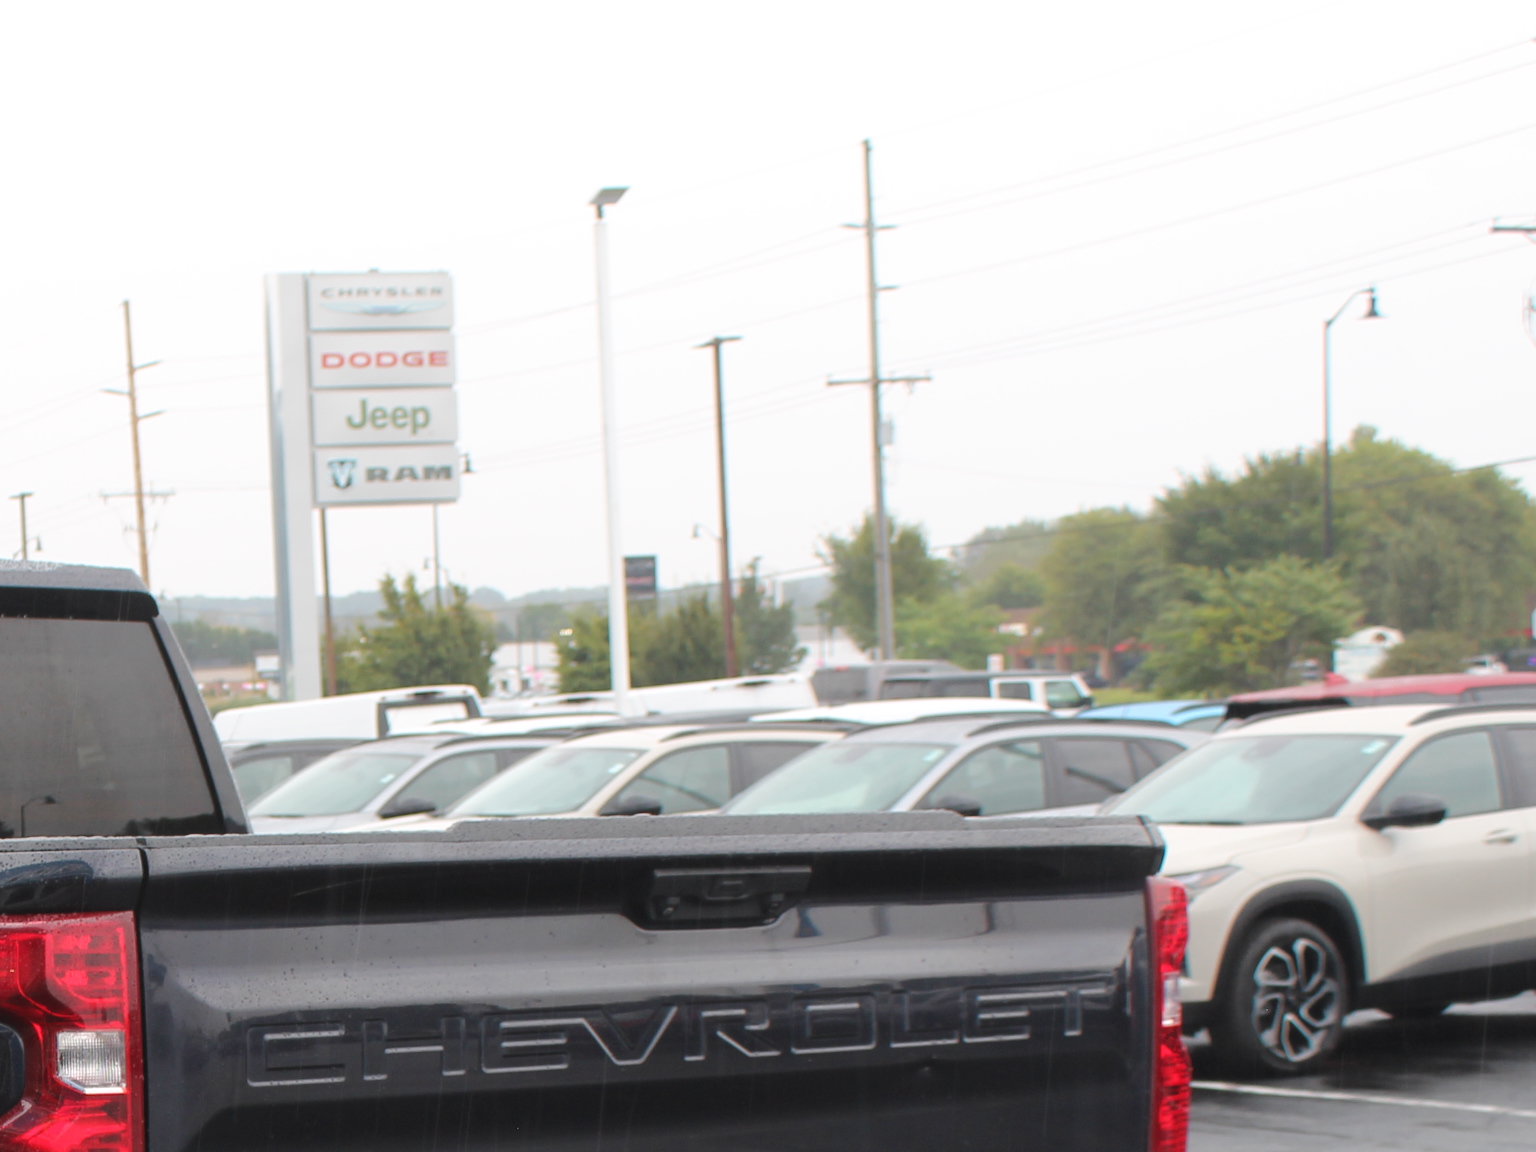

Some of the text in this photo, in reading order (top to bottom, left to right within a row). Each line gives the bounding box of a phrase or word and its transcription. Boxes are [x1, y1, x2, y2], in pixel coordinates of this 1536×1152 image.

[320, 286, 444, 299] CHRYSLER
[321, 351, 450, 369] DODGE
[346, 398, 432, 435] Jeep
[366, 465, 454, 484] RAM
[246, 976, 1110, 1088] CHEVROLET
